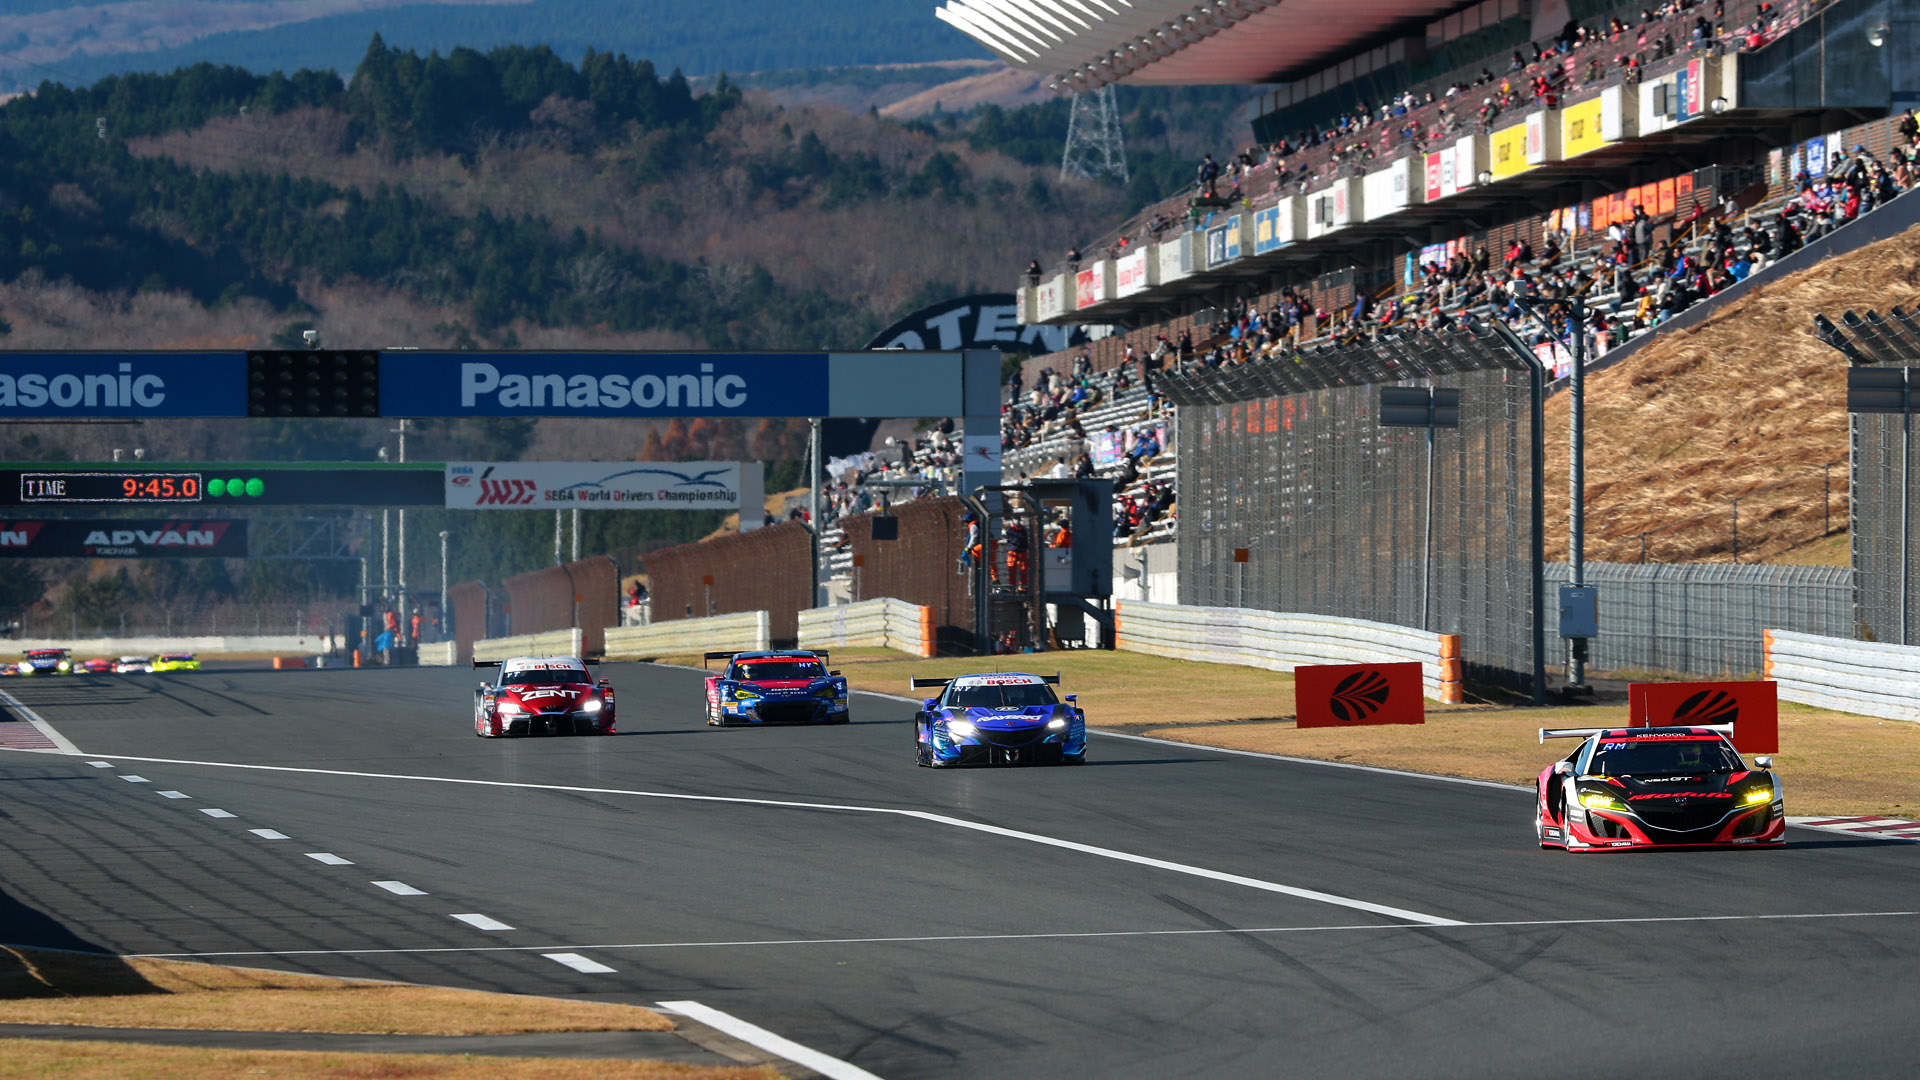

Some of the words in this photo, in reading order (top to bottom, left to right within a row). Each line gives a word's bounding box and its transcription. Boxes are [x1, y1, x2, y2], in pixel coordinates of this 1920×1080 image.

[460, 362, 748, 408] Panasonic
[26, 480, 66, 496] TIME
[123, 478, 197, 497] 9:45.0
[544, 490, 574, 501] SEGA
[577, 490, 610, 501] World
[613, 489, 654, 501] Drivers
[657, 489, 737, 503] Championship
[83, 529, 215, 546] ADVAN
[520, 689, 581, 702] ZENT
[1602, 742, 1627, 751] RM
[1627, 791, 1733, 801] Modulo
